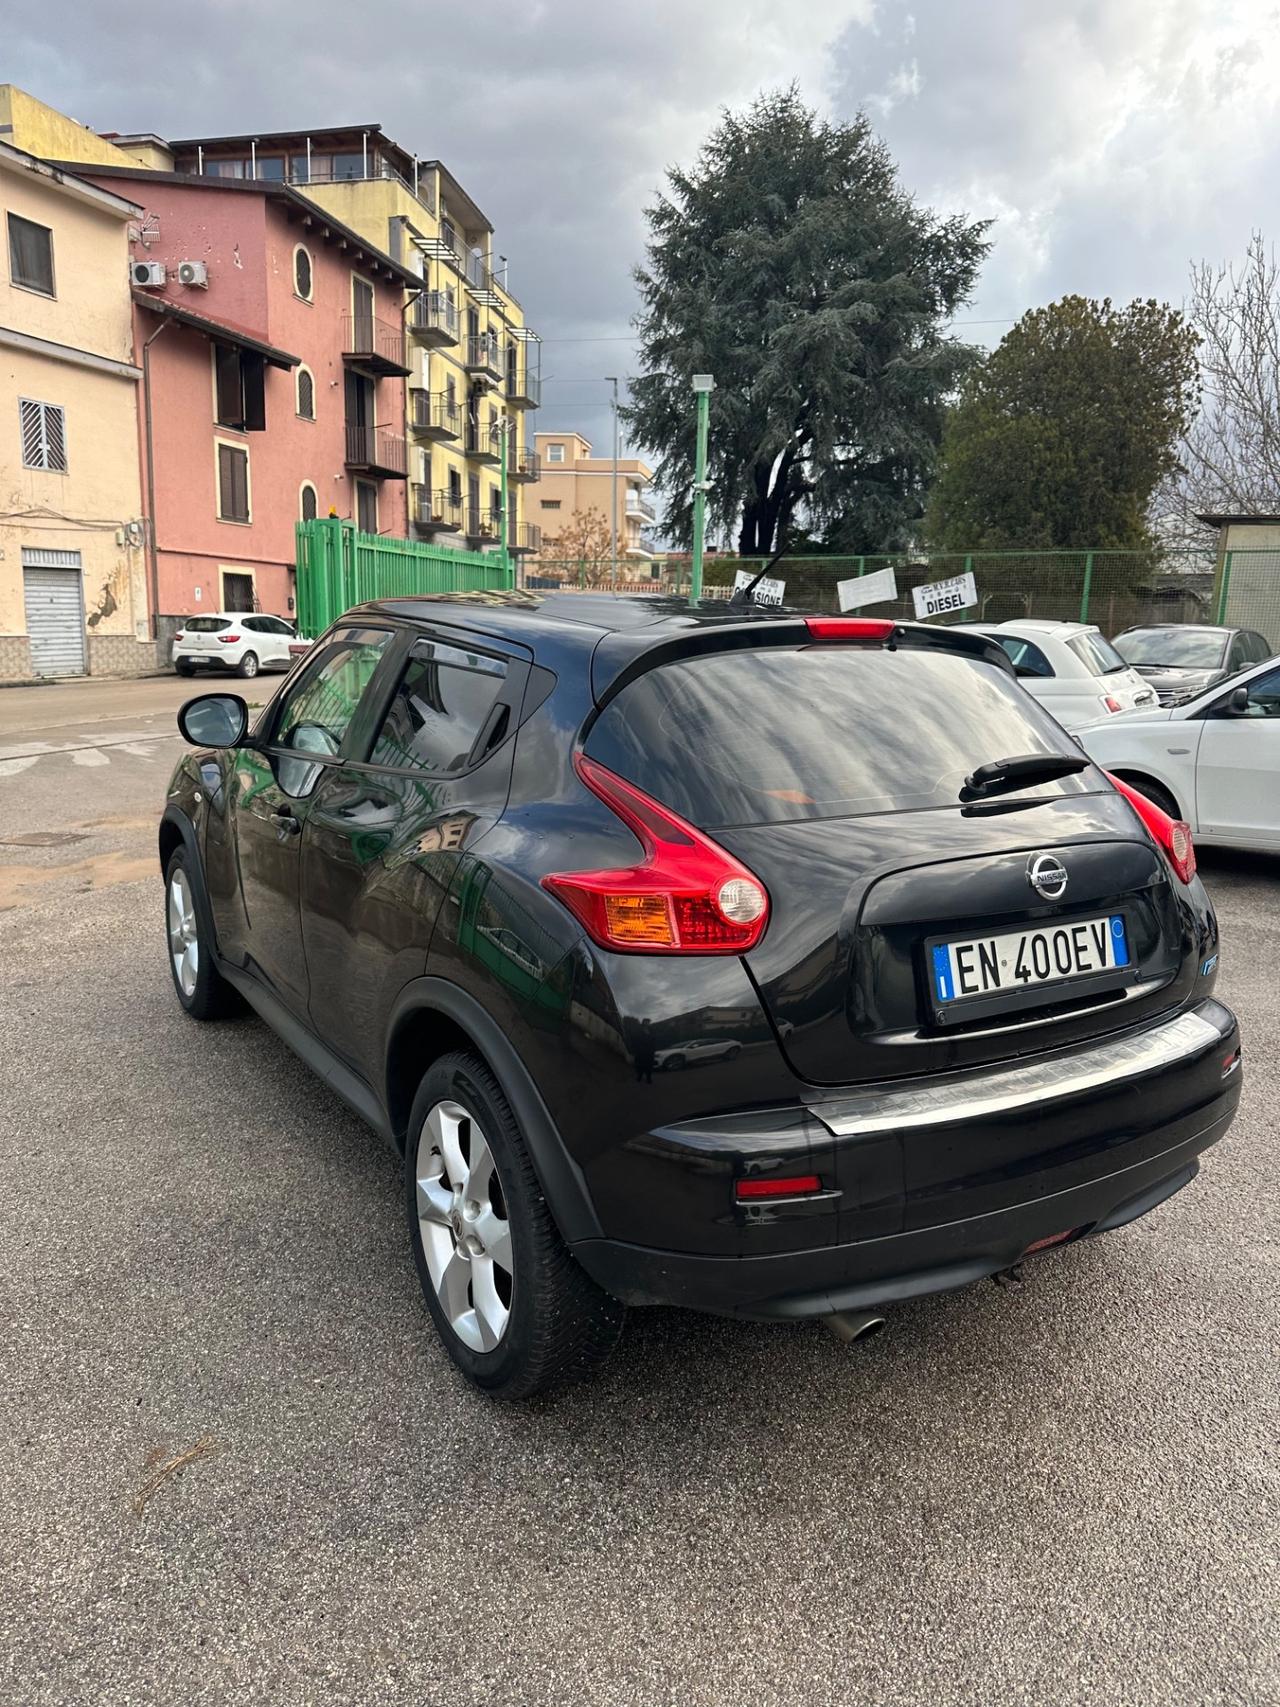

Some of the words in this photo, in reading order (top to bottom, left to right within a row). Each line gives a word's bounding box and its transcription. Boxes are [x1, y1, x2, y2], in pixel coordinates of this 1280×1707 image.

[735, 586, 782, 606] SIONE
[927, 593, 966, 615] DIESEL
[1037, 871, 1066, 882] NISSAN
[956, 940, 1001, 994] EN
[1014, 922, 1107, 983] 400EV
